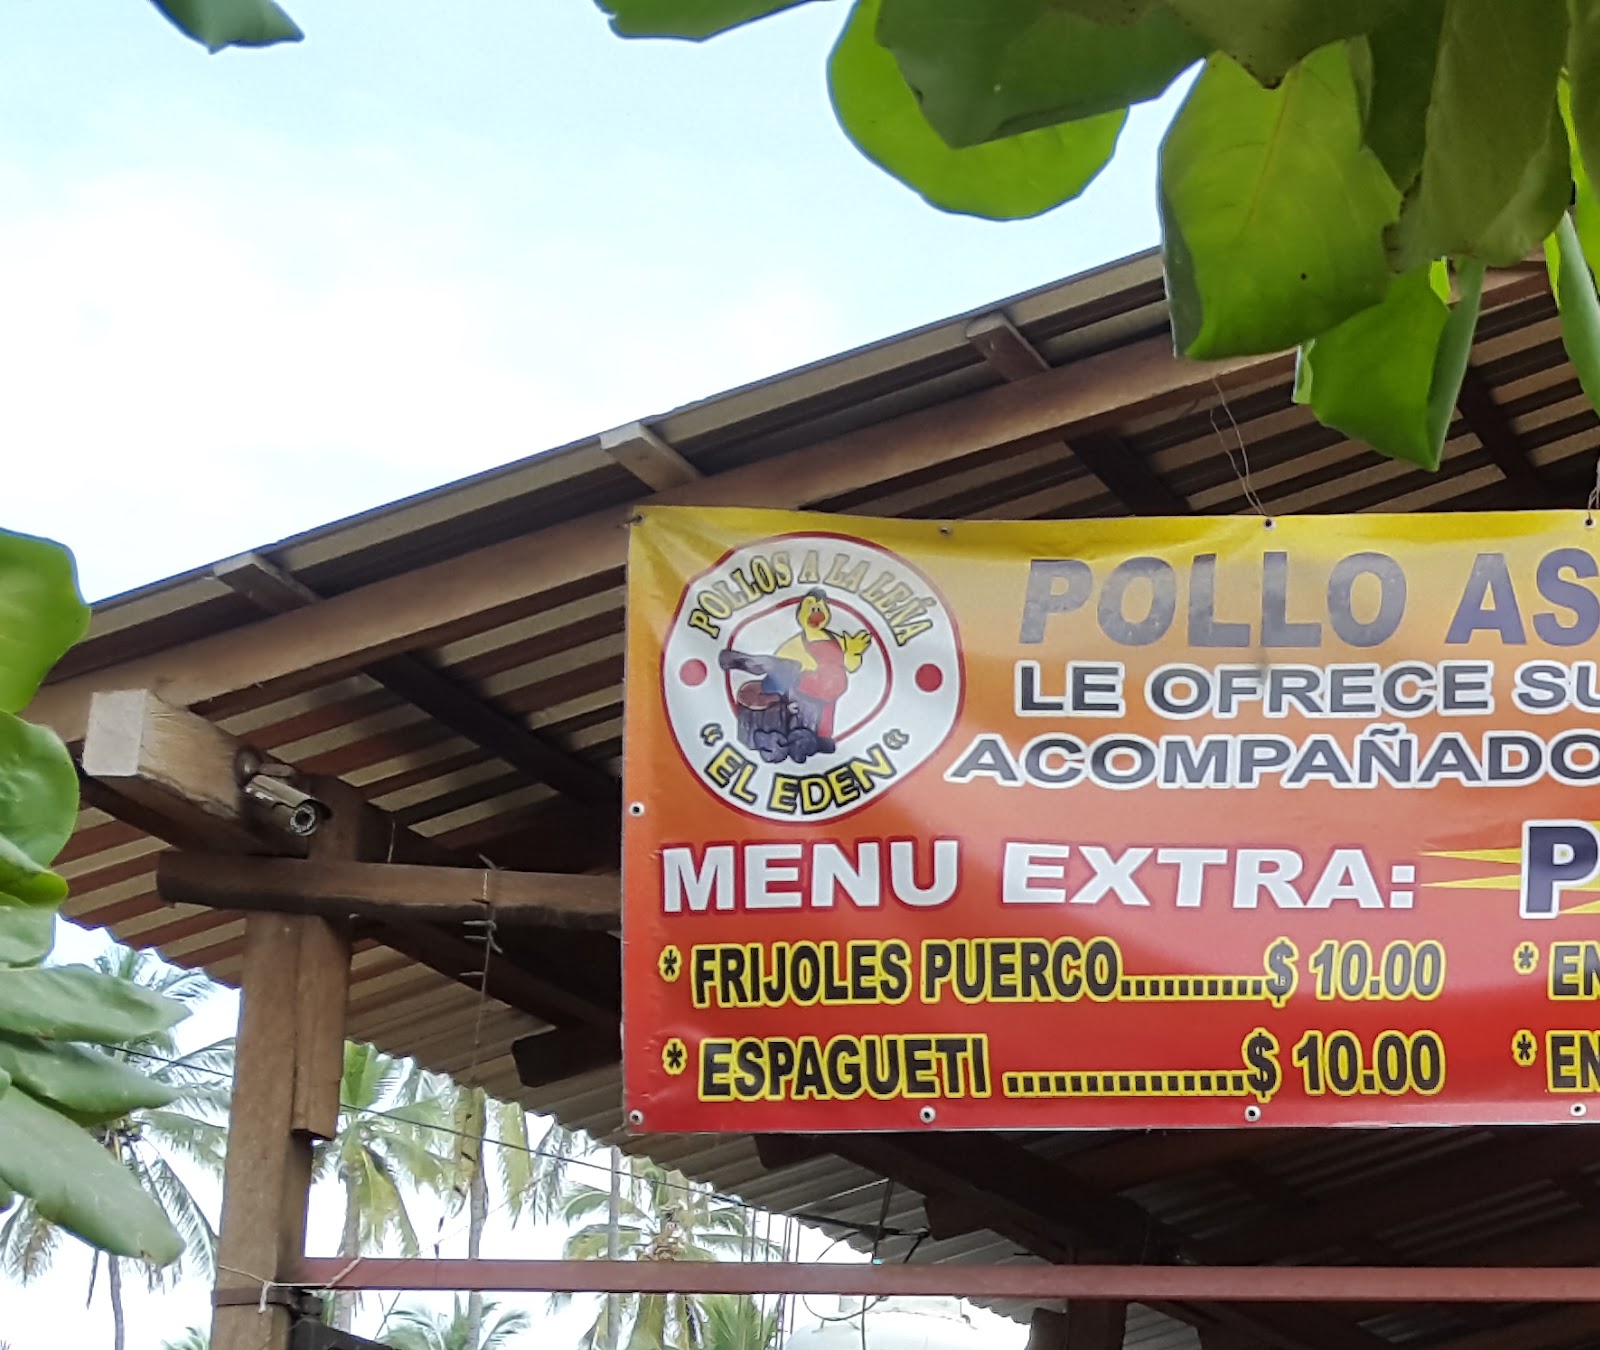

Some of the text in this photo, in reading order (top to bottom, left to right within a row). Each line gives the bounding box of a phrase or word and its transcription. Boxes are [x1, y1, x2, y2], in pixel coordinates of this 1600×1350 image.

[688, 550, 937, 646] POLLOS A LA LEÑA
[1019, 551, 1406, 648] POLLO
[1015, 661, 1125, 716] LE
[1145, 661, 1494, 717] OFRECE
[661, 839, 1416, 912] MENU EXTRA:
[691, 940, 912, 1007] FRIJOLES
[698, 1034, 991, 1101] ESPAGUETI
